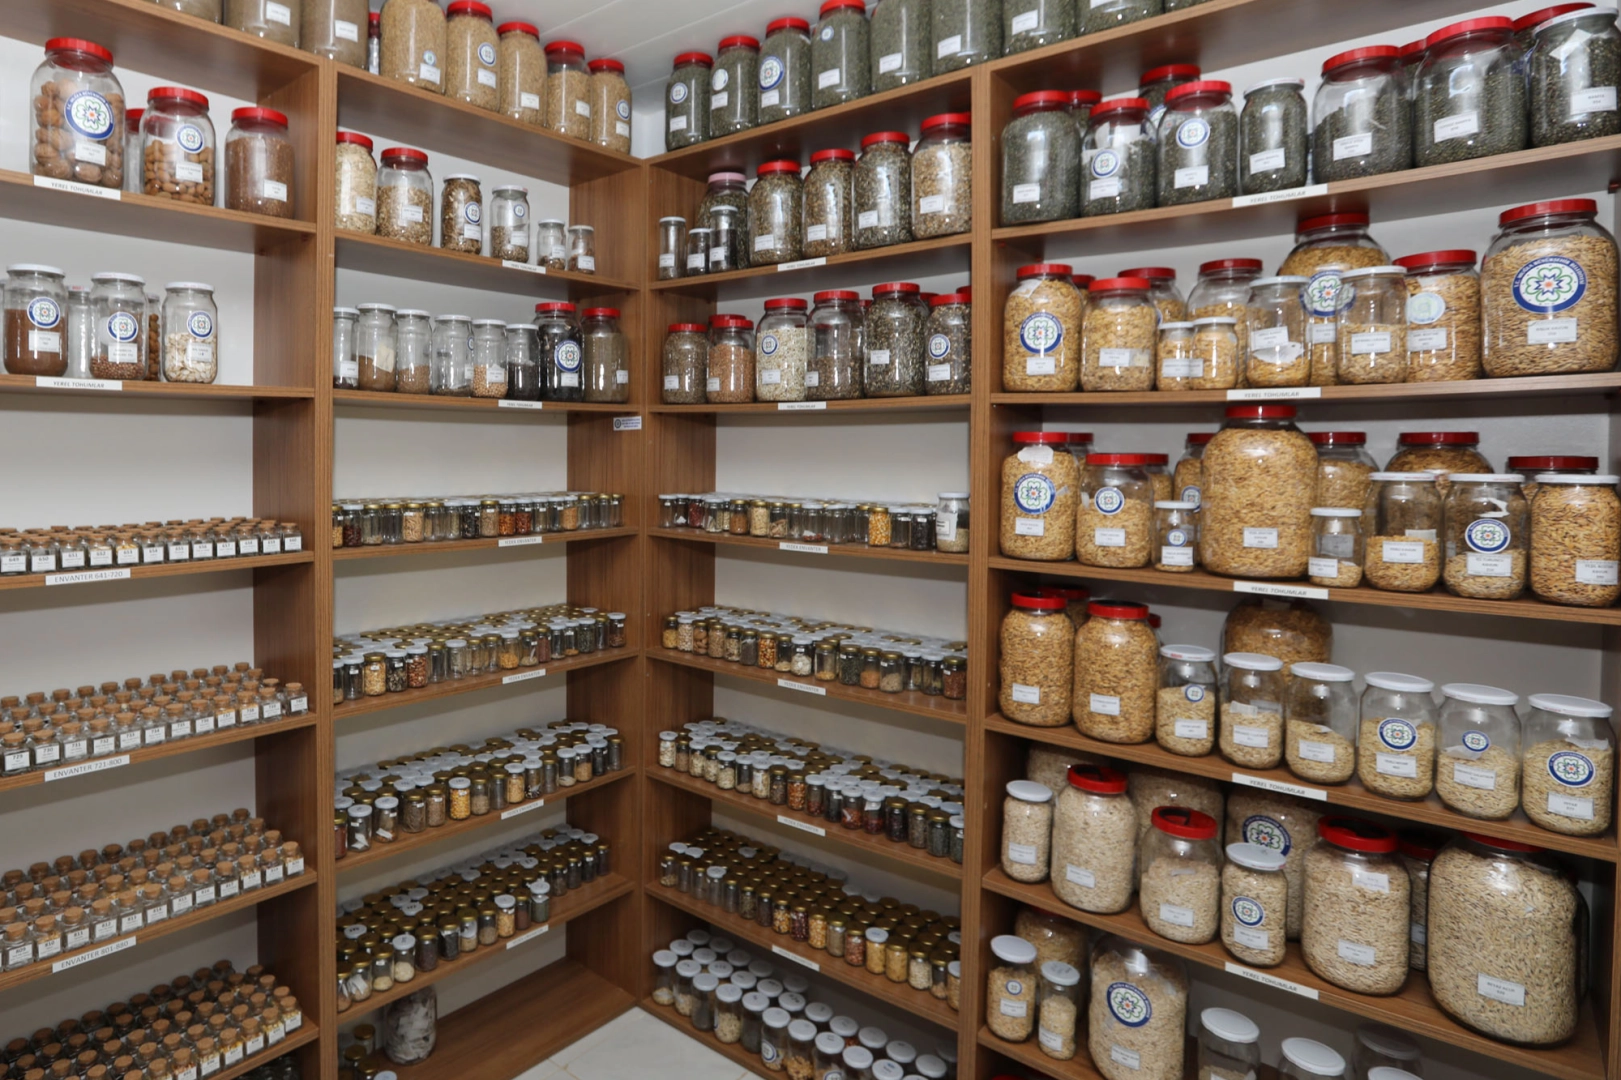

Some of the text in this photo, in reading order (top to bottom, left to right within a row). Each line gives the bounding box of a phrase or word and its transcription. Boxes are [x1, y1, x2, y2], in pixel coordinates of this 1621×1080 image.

[54, 570, 122, 582] ENVANTER 641-720
[52, 764, 92, 778] ENVANTER
[1249, 779, 1305, 794] YEREL TOHUMLAR
[60, 950, 99, 968] ENVANTER
[1241, 970, 1297, 991] YEREL TOHUMLAR
